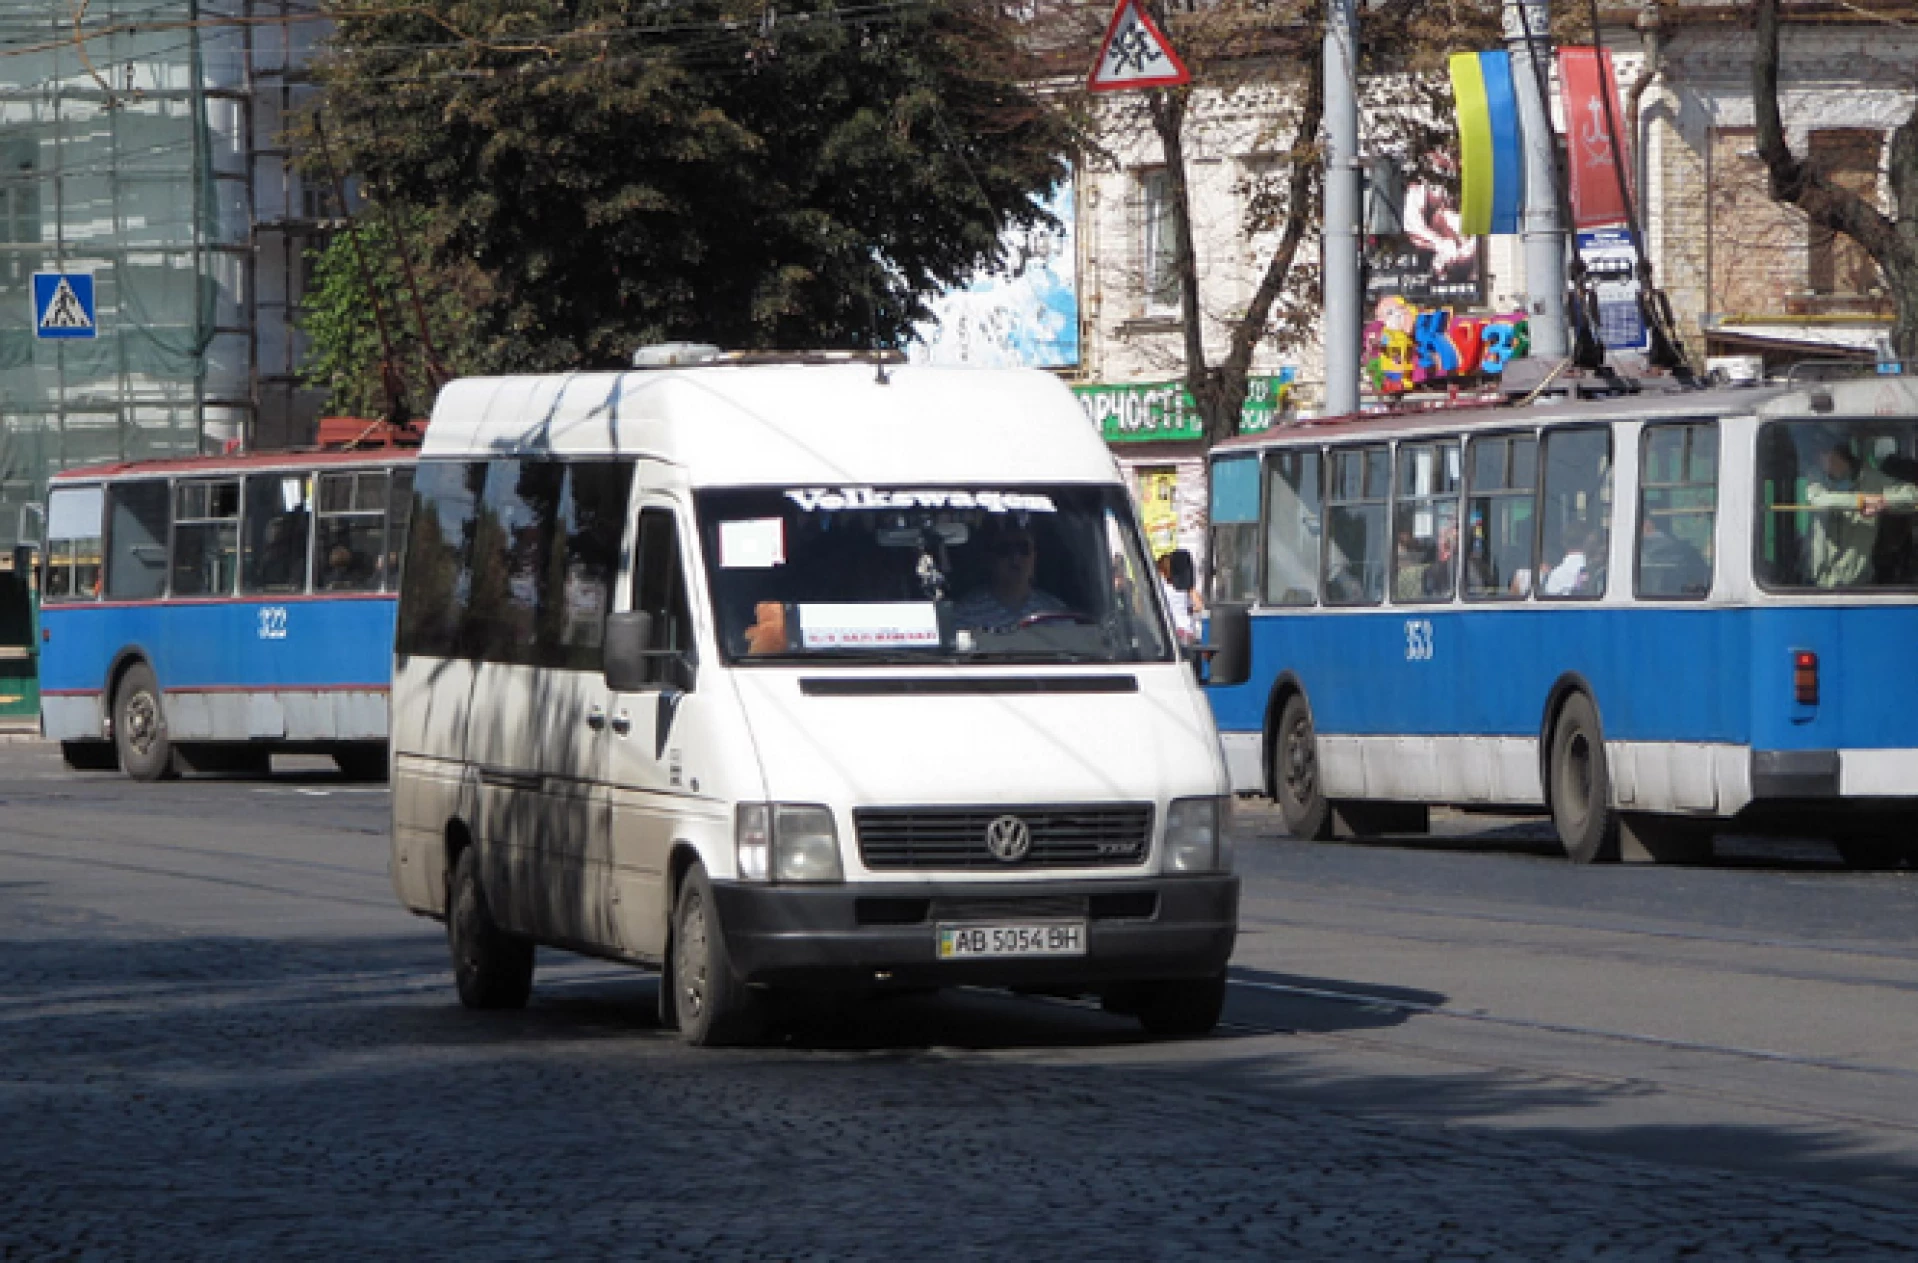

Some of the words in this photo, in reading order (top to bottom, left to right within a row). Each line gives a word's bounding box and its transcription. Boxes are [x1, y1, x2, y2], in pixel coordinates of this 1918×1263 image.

[782, 487, 1057, 512] Volkswagen
[1404, 620, 1433, 660] 353
[993, 930, 1043, 951] 5054
